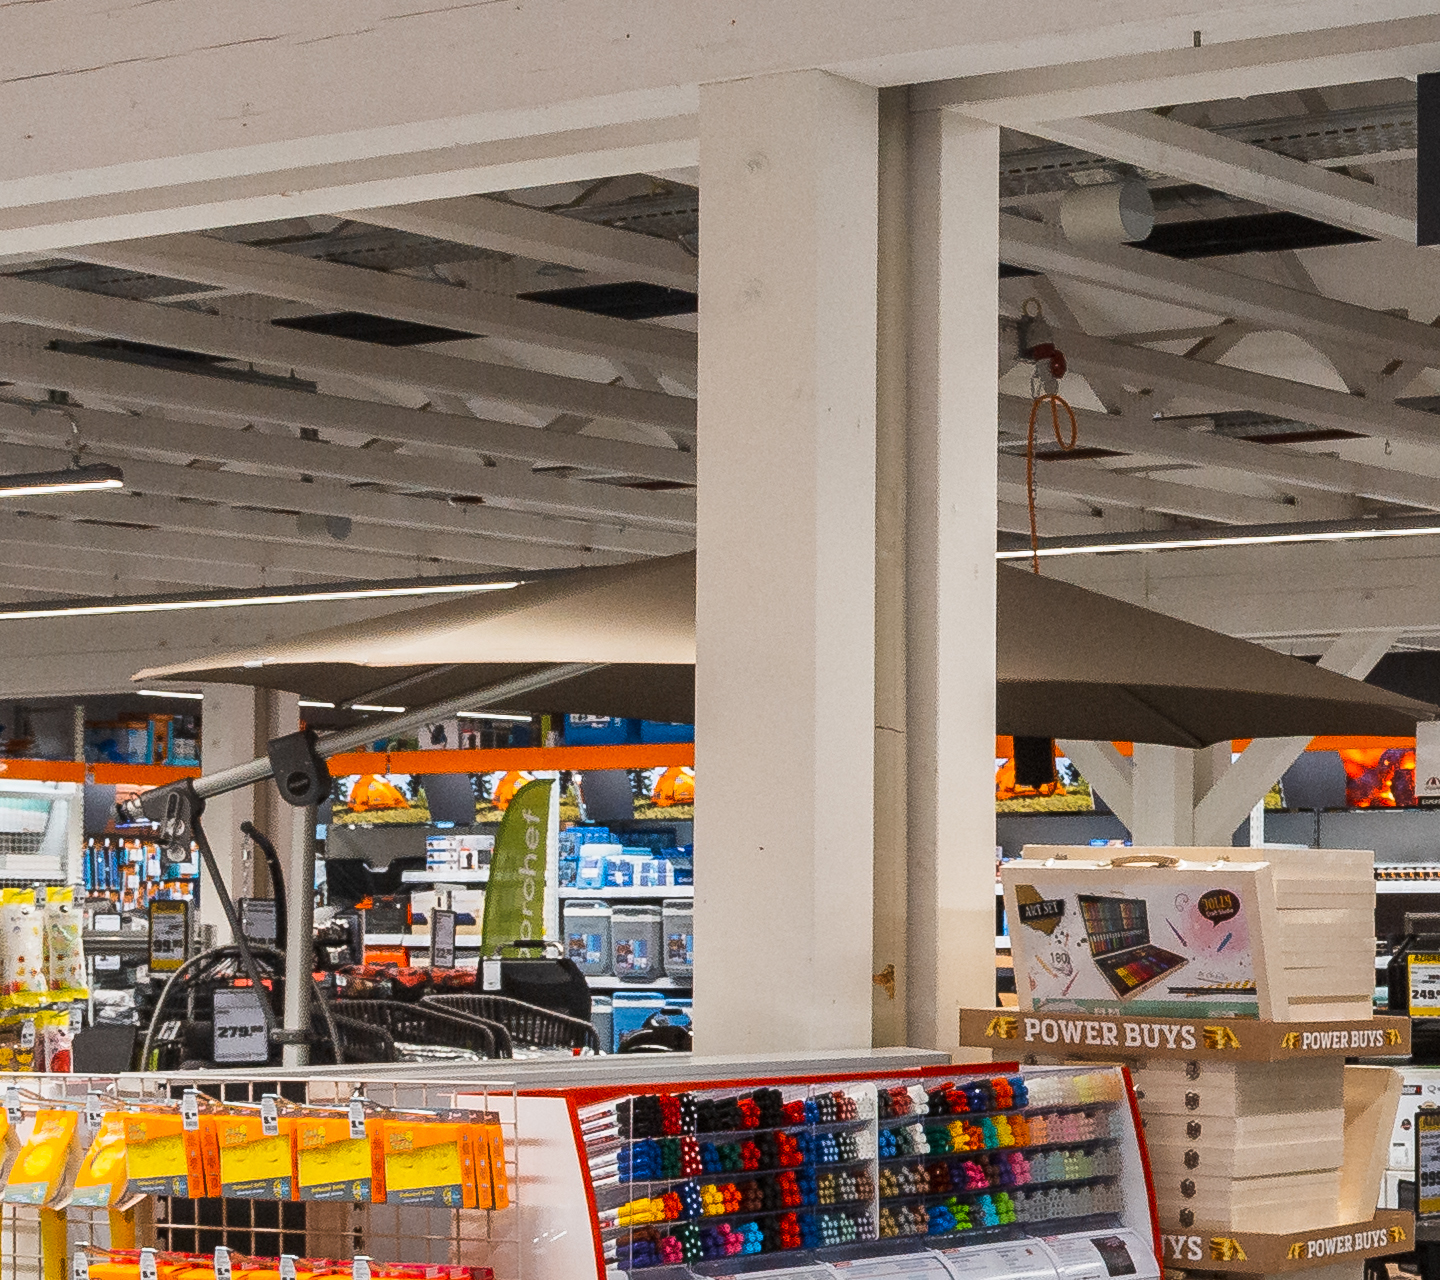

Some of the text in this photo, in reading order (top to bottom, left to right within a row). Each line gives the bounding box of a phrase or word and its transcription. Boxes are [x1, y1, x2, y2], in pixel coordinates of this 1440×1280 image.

[1025, 902, 1059, 918] ART SET
[1023, 1017, 1197, 1050] POWER BUYS
[1301, 1028, 1385, 1051] POWER BUYS
[1306, 1229, 1388, 1260] POWER BUYS
